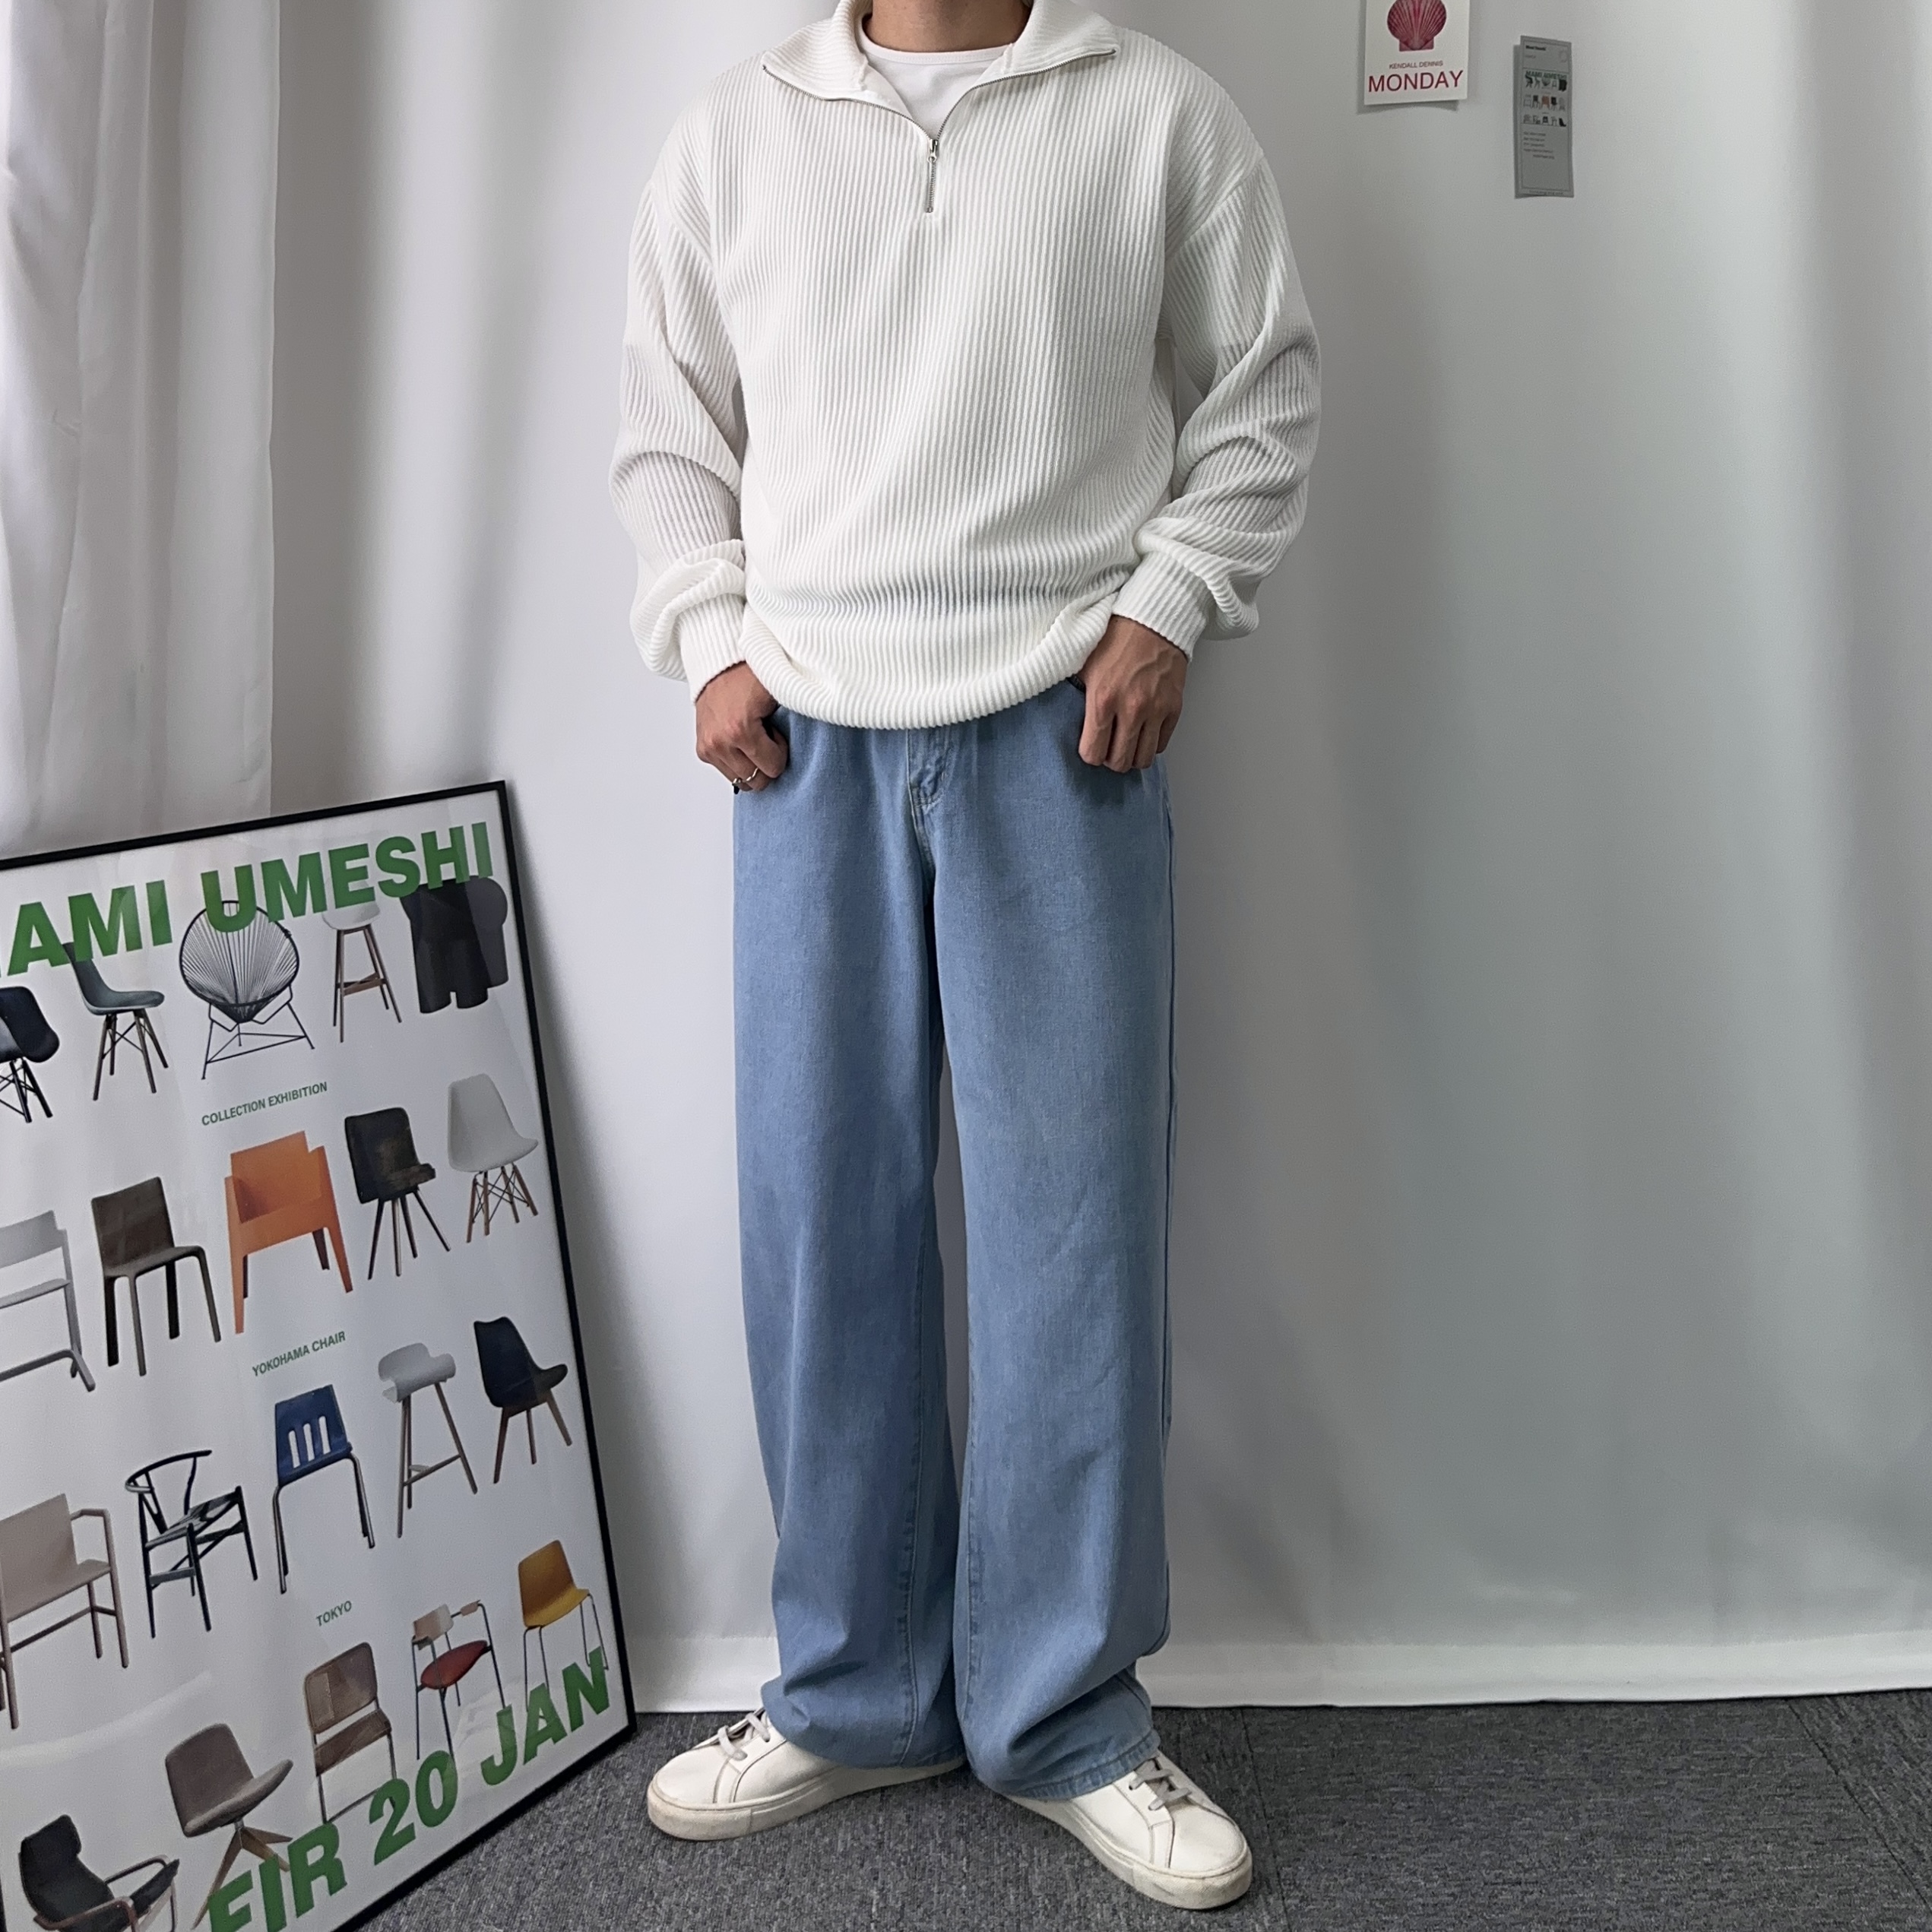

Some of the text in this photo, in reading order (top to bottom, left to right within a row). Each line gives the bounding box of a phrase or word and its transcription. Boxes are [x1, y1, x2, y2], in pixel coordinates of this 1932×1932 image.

[1368, 70, 1464, 92] MONDAY
[0, 822, 493, 977] AMI UMESHI
[201, 1082, 328, 1126] COLLECTION EXHIBITION
[252, 1331, 346, 1377] YOKOHAMA CHAIR
[316, 1600, 352, 1627] TOKYO
[369, 1750, 458, 1866] 20
[480, 1645, 610, 1786] JAN
